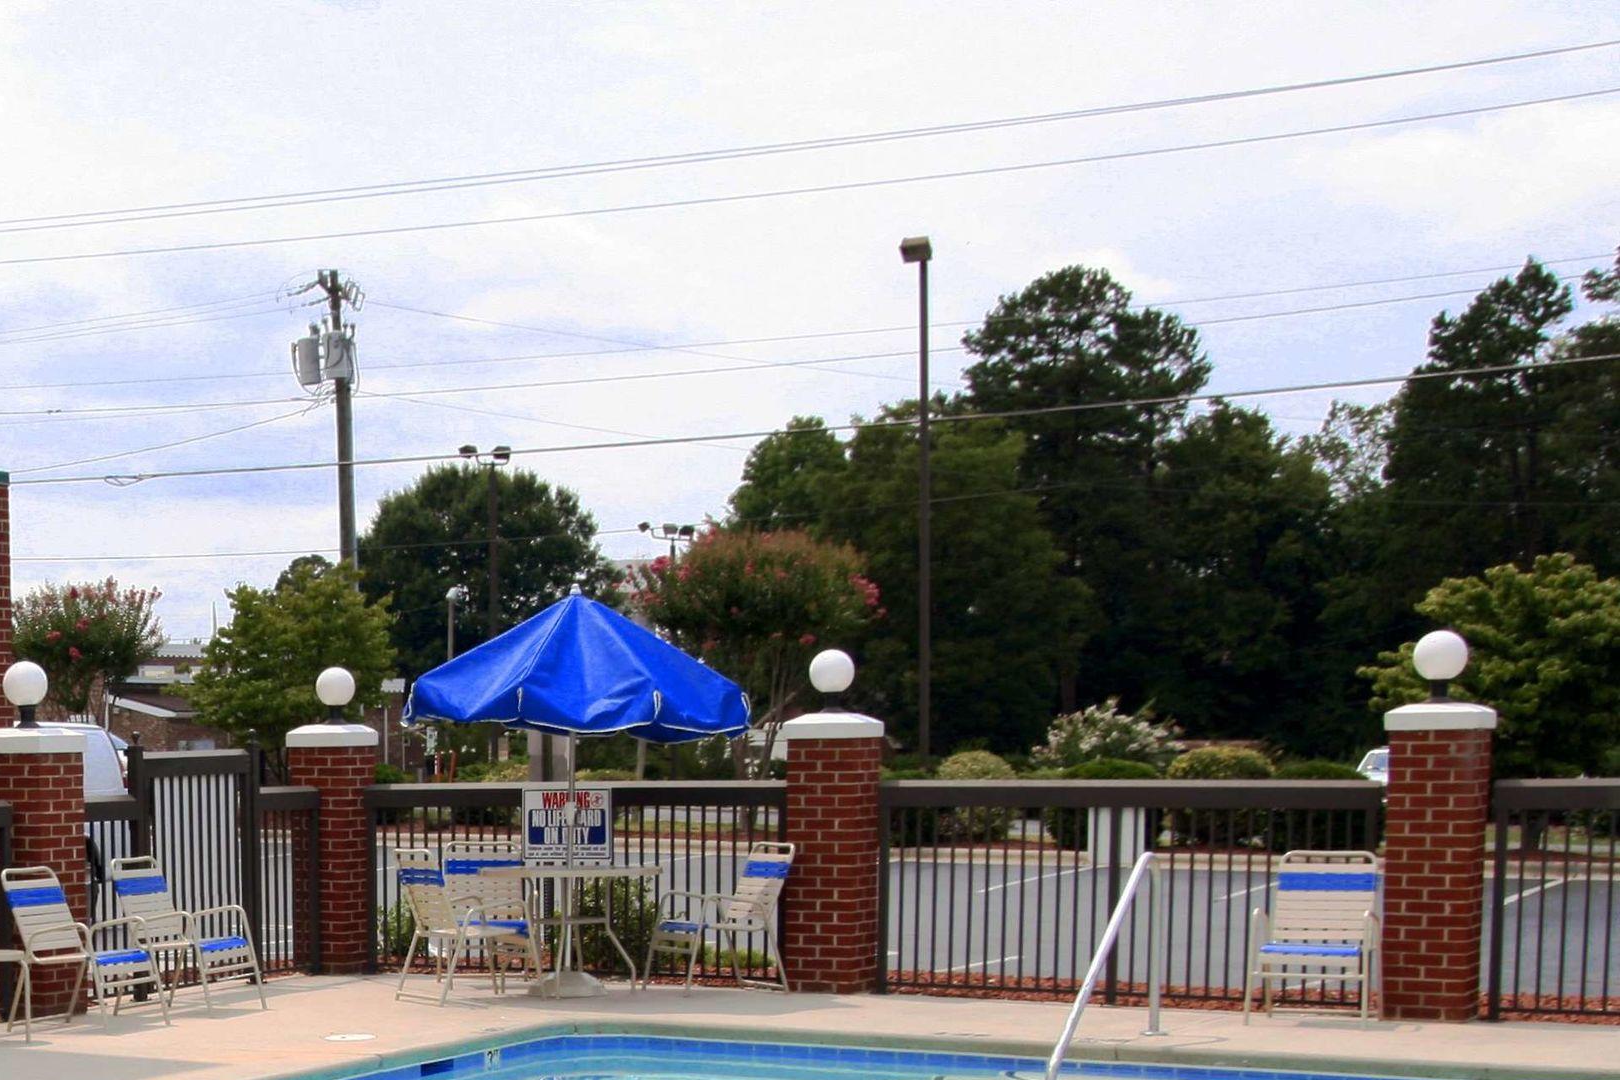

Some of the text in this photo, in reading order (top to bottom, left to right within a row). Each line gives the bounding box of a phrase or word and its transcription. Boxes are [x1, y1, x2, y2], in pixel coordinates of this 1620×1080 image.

[542, 792, 590, 809] WARNG
[532, 810, 546, 827] NO
[544, 827, 559, 844] ON
